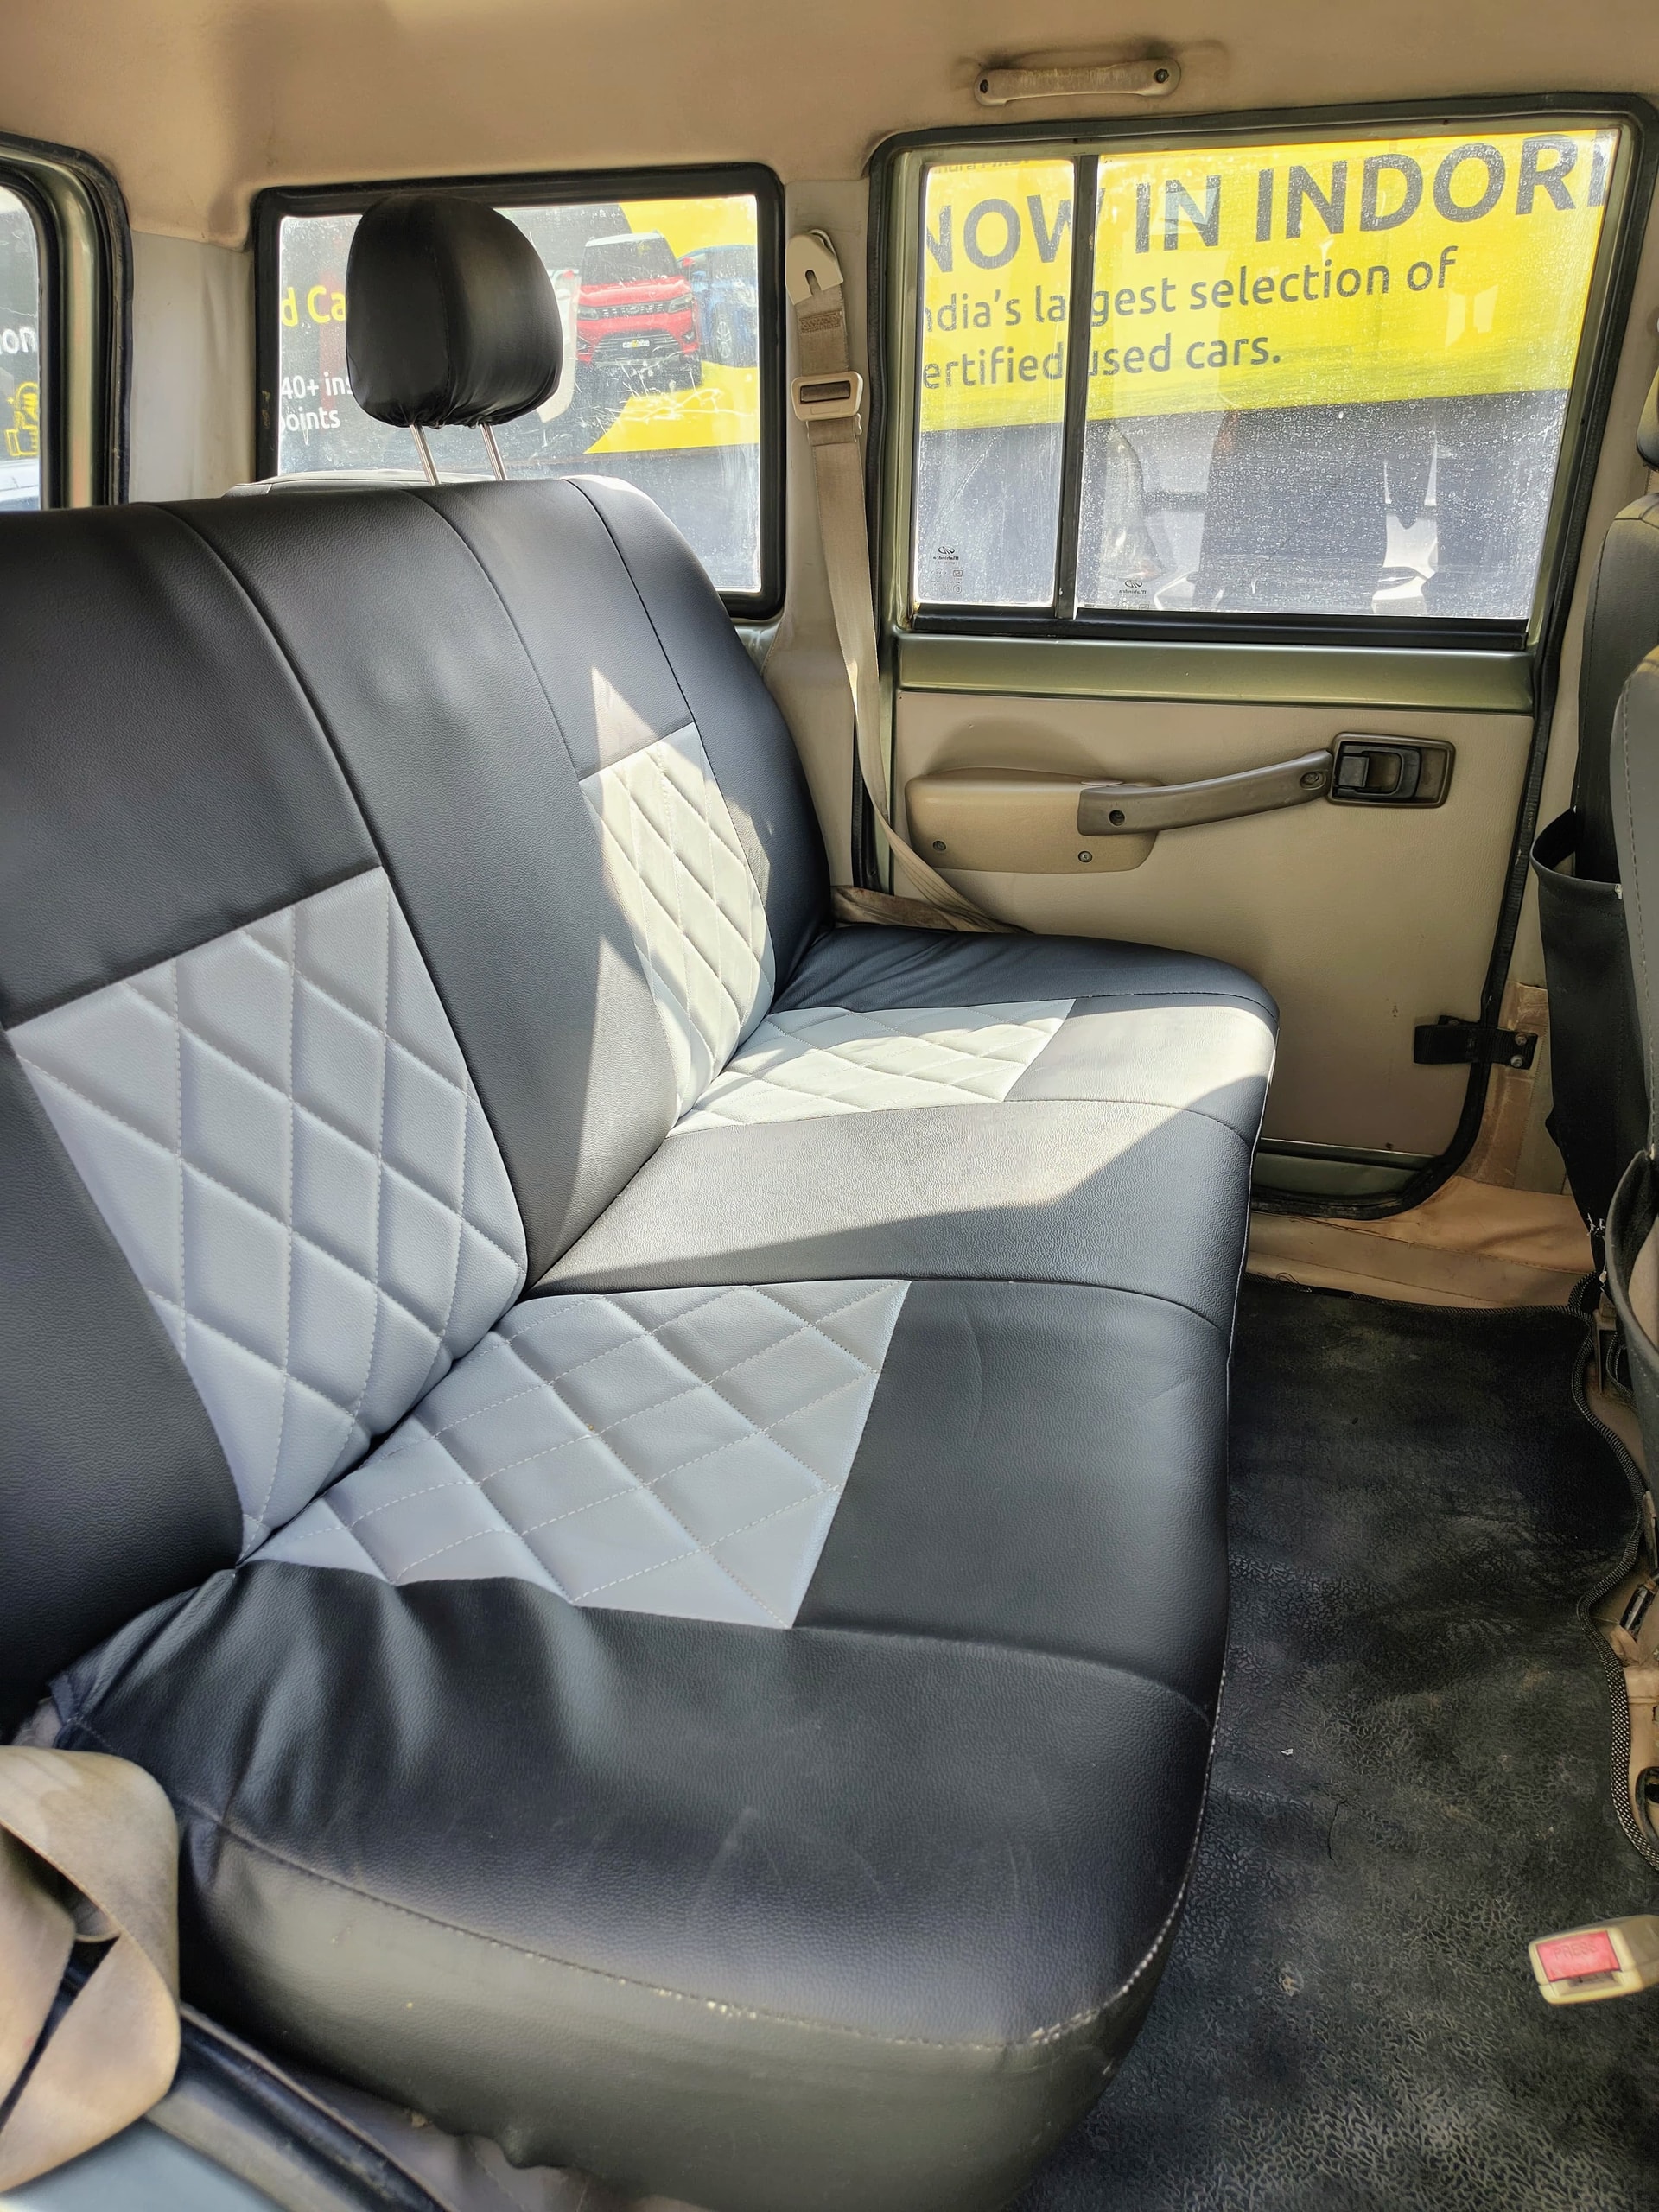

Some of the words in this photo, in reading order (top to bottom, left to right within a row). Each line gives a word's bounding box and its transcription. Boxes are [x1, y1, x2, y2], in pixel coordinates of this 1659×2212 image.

[1135, 175, 1222, 253] IN
[1035, 277, 1176, 327] lagest
[1189, 259, 1389, 309] selection
[1407, 245, 1458, 291] of
[1186, 337, 1281, 369] cars.
[1553, 1941, 1598, 1961] PRESS
